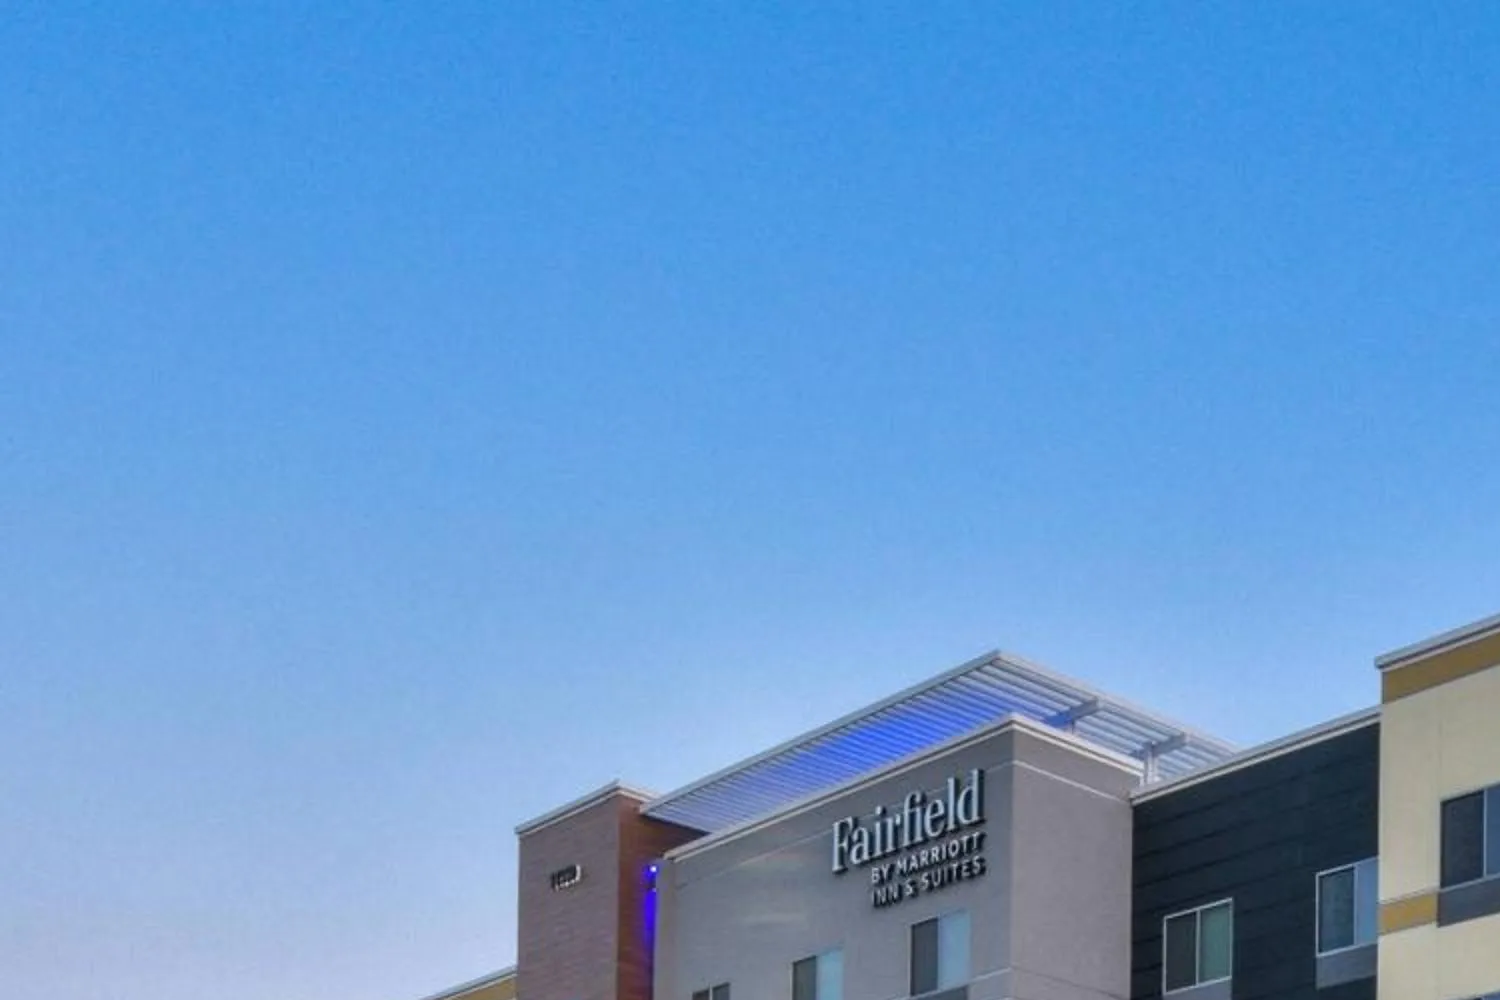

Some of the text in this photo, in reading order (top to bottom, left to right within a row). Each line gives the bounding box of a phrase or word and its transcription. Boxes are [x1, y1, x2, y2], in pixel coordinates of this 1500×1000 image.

[831, 768, 984, 873] Fairfield
[871, 831, 983, 884] BY MARRIOTT
[872, 883, 902, 906] INN
[920, 855, 983, 892] SUITES
